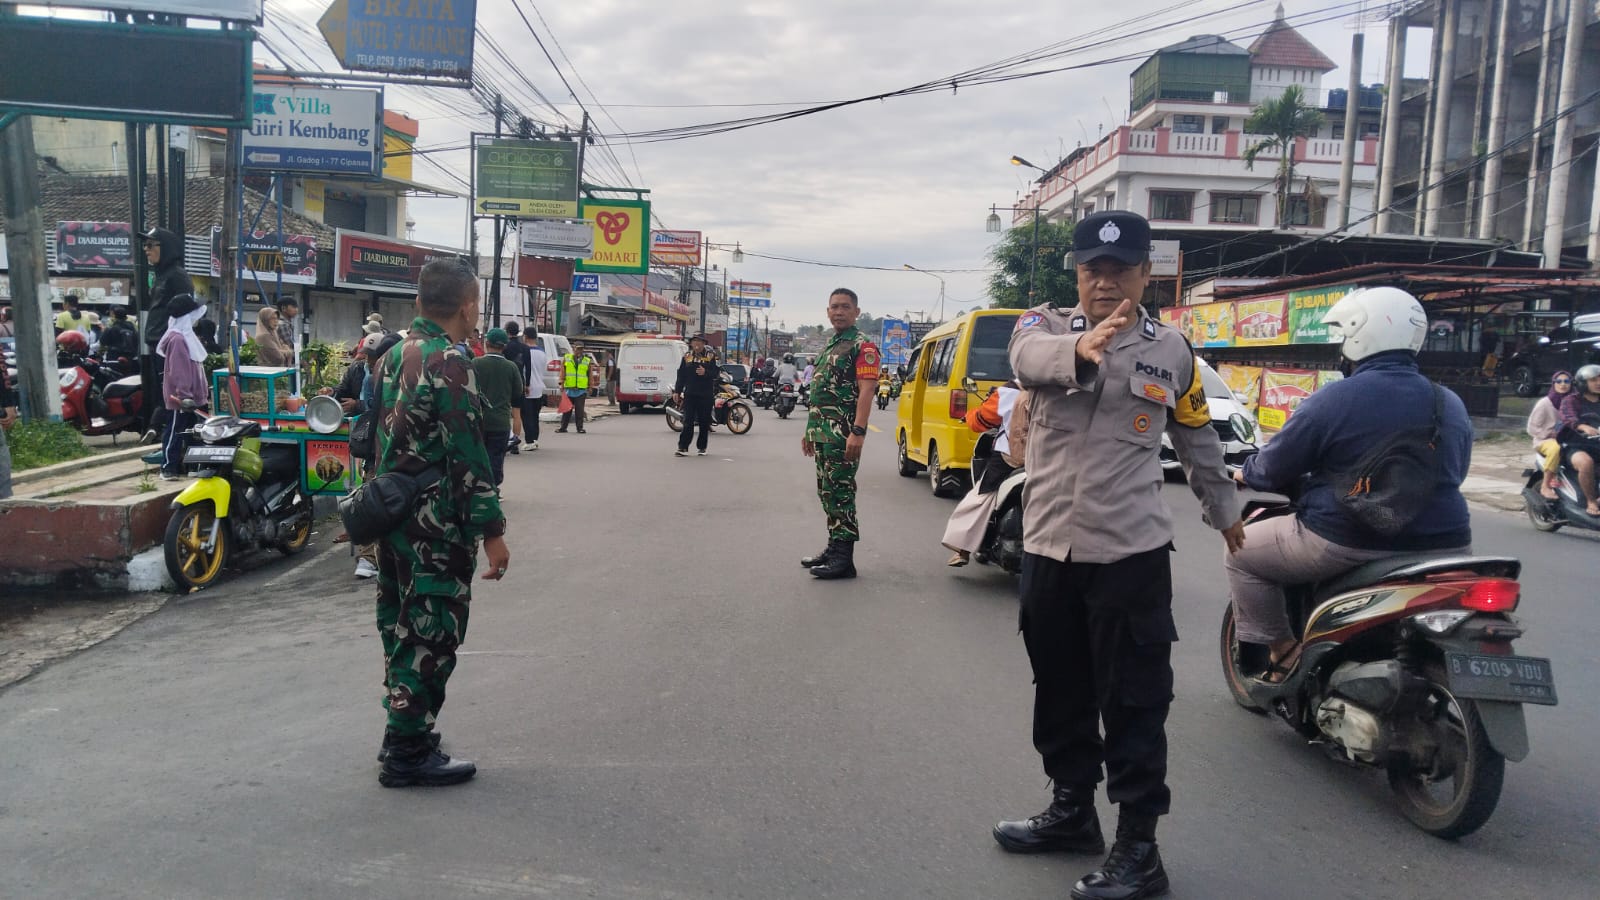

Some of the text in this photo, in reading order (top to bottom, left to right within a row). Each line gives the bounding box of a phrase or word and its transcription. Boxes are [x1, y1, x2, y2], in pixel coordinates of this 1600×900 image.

[365, 0, 456, 21] BRATA
[350, 18, 388, 51] HOTEL
[408, 24, 466, 57] KARAOKE
[280, 96, 331, 115] Villa
[289, 119, 370, 147] Kembang
[78, 236, 130, 246] DJARUM SUPER
[364, 251, 408, 267] DJARUM SUPER
[590, 251, 638, 263] OMART
[1135, 361, 1173, 382] POLRI
[1452, 658, 1461, 674] B
[1470, 660, 1512, 677] 6209
